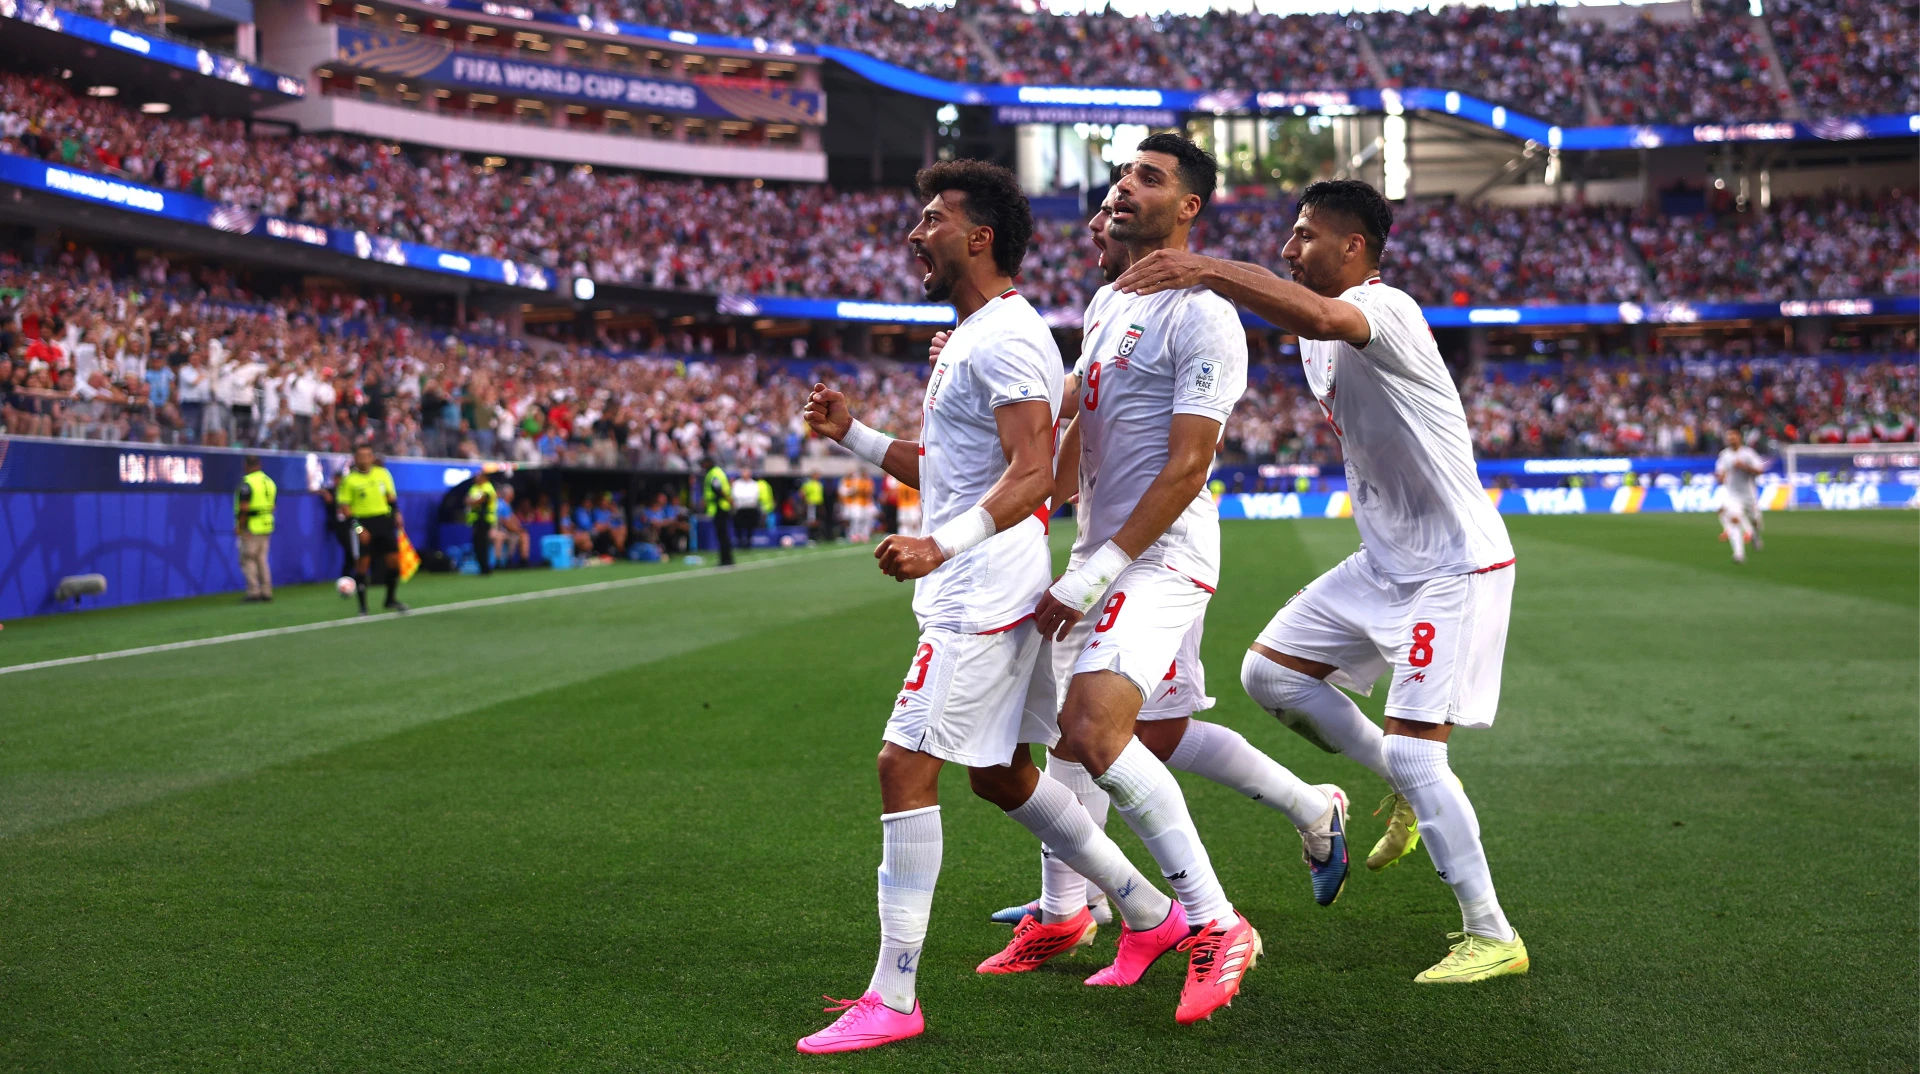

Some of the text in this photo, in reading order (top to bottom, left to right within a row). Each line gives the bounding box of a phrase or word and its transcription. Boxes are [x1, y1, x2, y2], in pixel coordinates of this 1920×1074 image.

[454, 57, 696, 109] FIFA WORLD CUP 2026
[1084, 361, 1102, 411] 9
[1195, 379, 1212, 390] PEACE
[1240, 492, 1302, 519] VISA
[1523, 487, 1587, 514] VISA
[1816, 483, 1880, 510] VISA
[1095, 592, 1126, 633] 9
[1408, 622, 1435, 667] 8
[904, 643, 933, 691] 3
